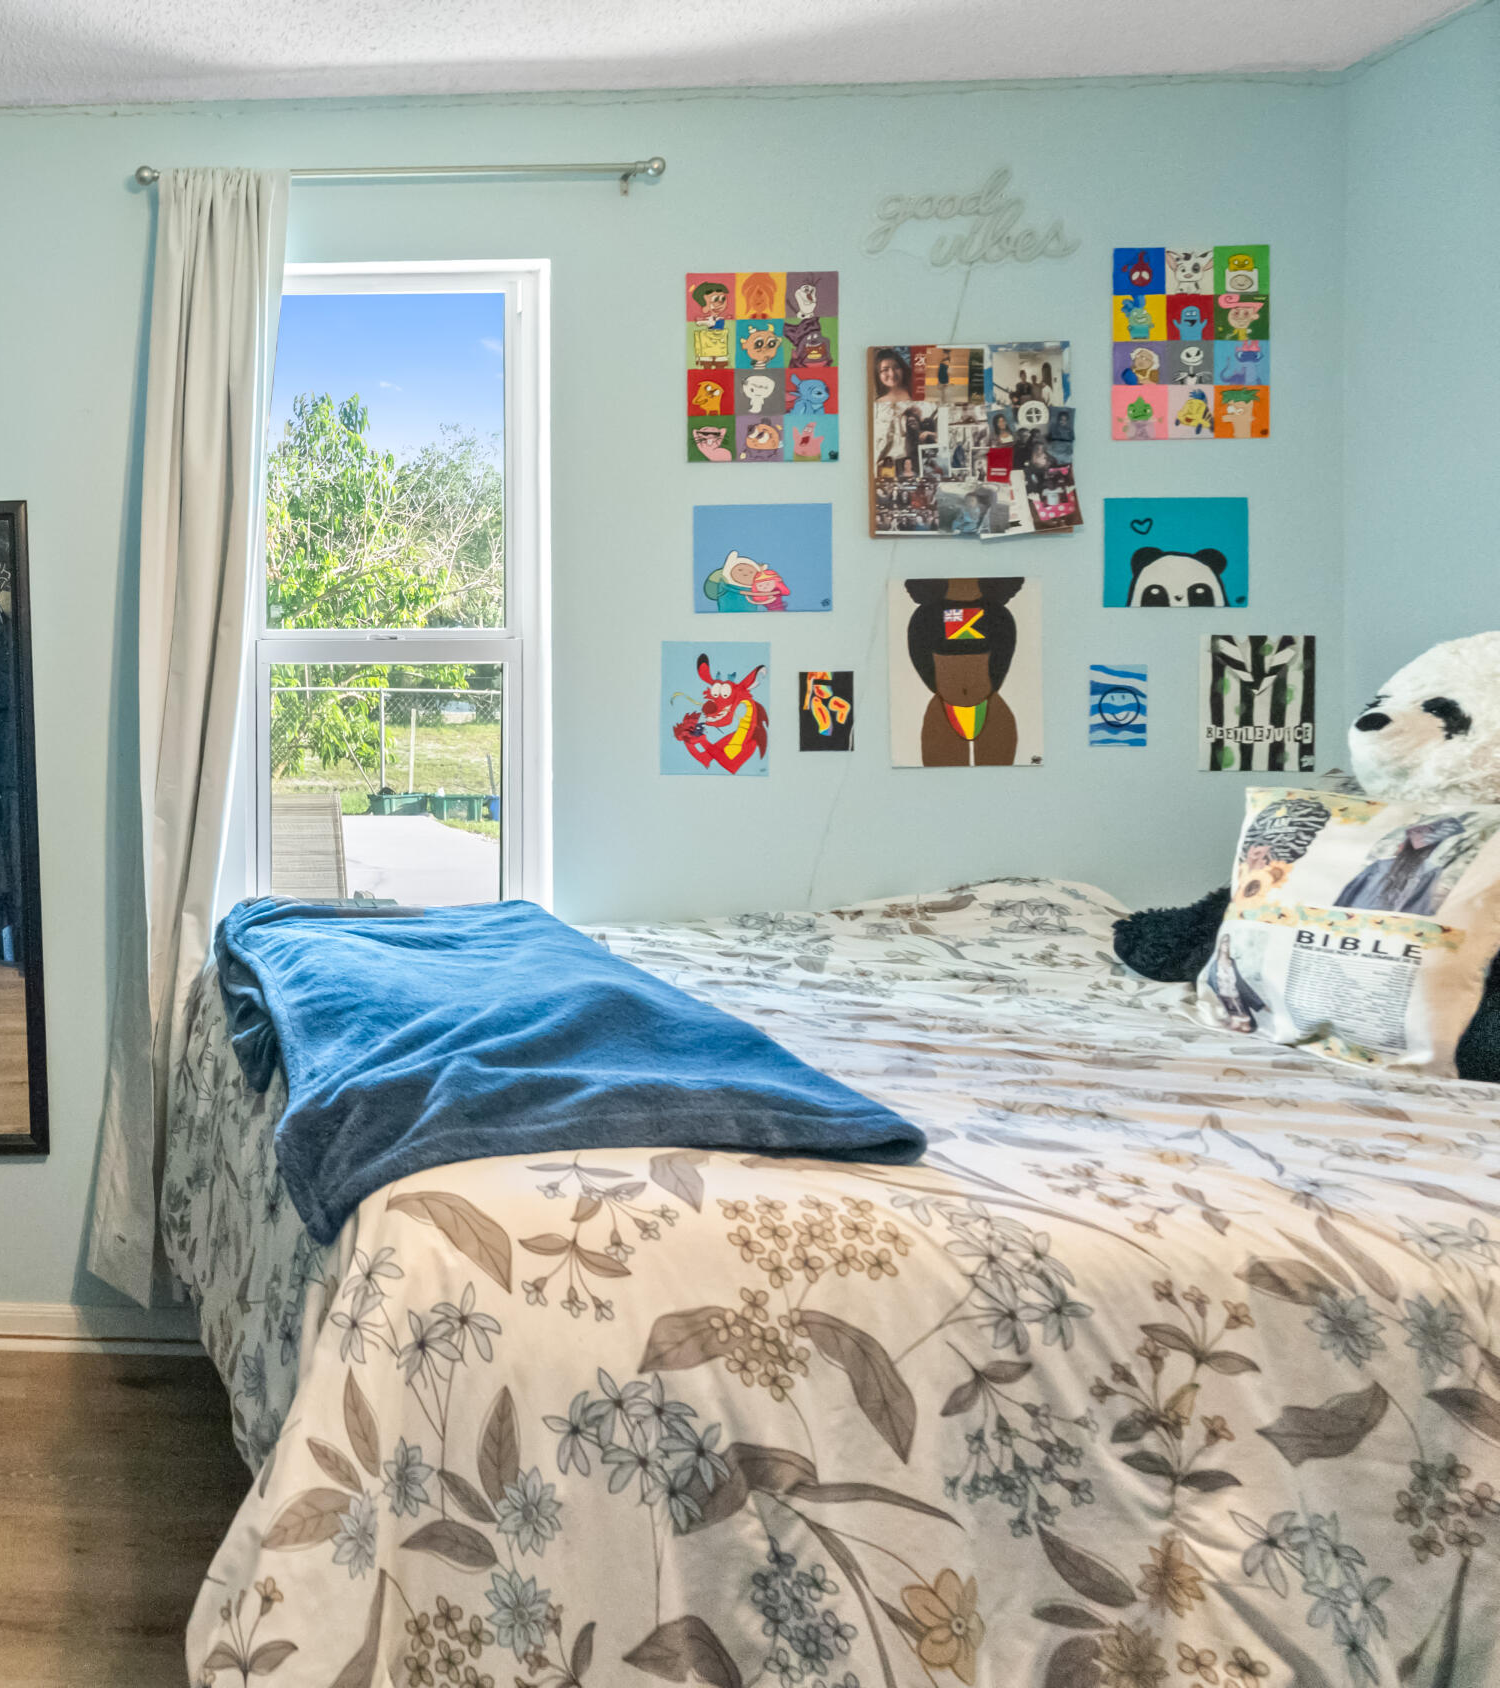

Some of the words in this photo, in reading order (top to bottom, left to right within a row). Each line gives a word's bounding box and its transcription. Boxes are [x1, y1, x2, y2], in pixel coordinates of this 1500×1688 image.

[864, 166, 1012, 255] good
[930, 197, 1082, 267] vibes
[1205, 725, 1312, 743] BEETLEJUICE
[1295, 929, 1423, 960] BIBLE
